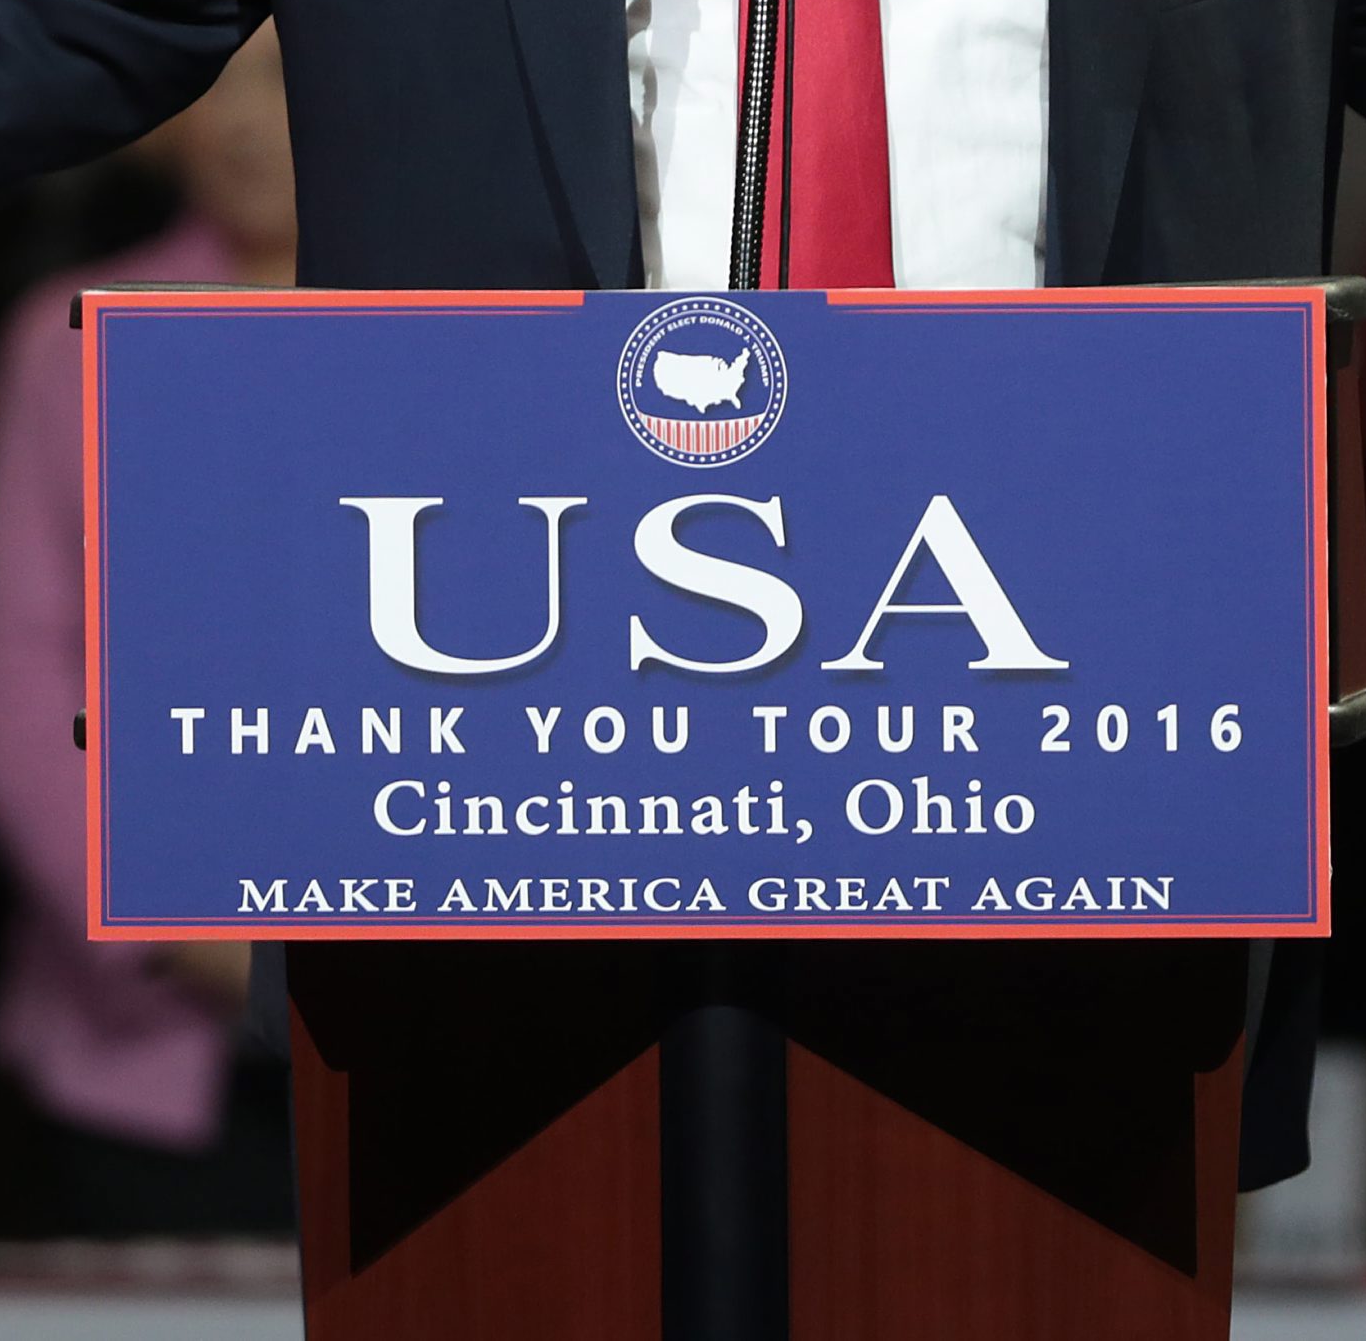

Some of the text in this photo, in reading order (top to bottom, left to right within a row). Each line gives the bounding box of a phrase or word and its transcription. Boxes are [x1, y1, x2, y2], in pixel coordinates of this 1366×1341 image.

[636, 329, 666, 387] PRESIDENT
[668, 316, 697, 332] ELECT
[699, 316, 743, 335] DONALD
[751, 343, 769, 387] TRUMP
[339, 494, 1069, 673] USA
[171, 704, 1241, 754] THANK YOU TOUR 2016
[374, 776, 1034, 844] Cincinnati, Ohio
[238, 877, 1174, 912] MAKE AMERICA GREAT AGAIN
